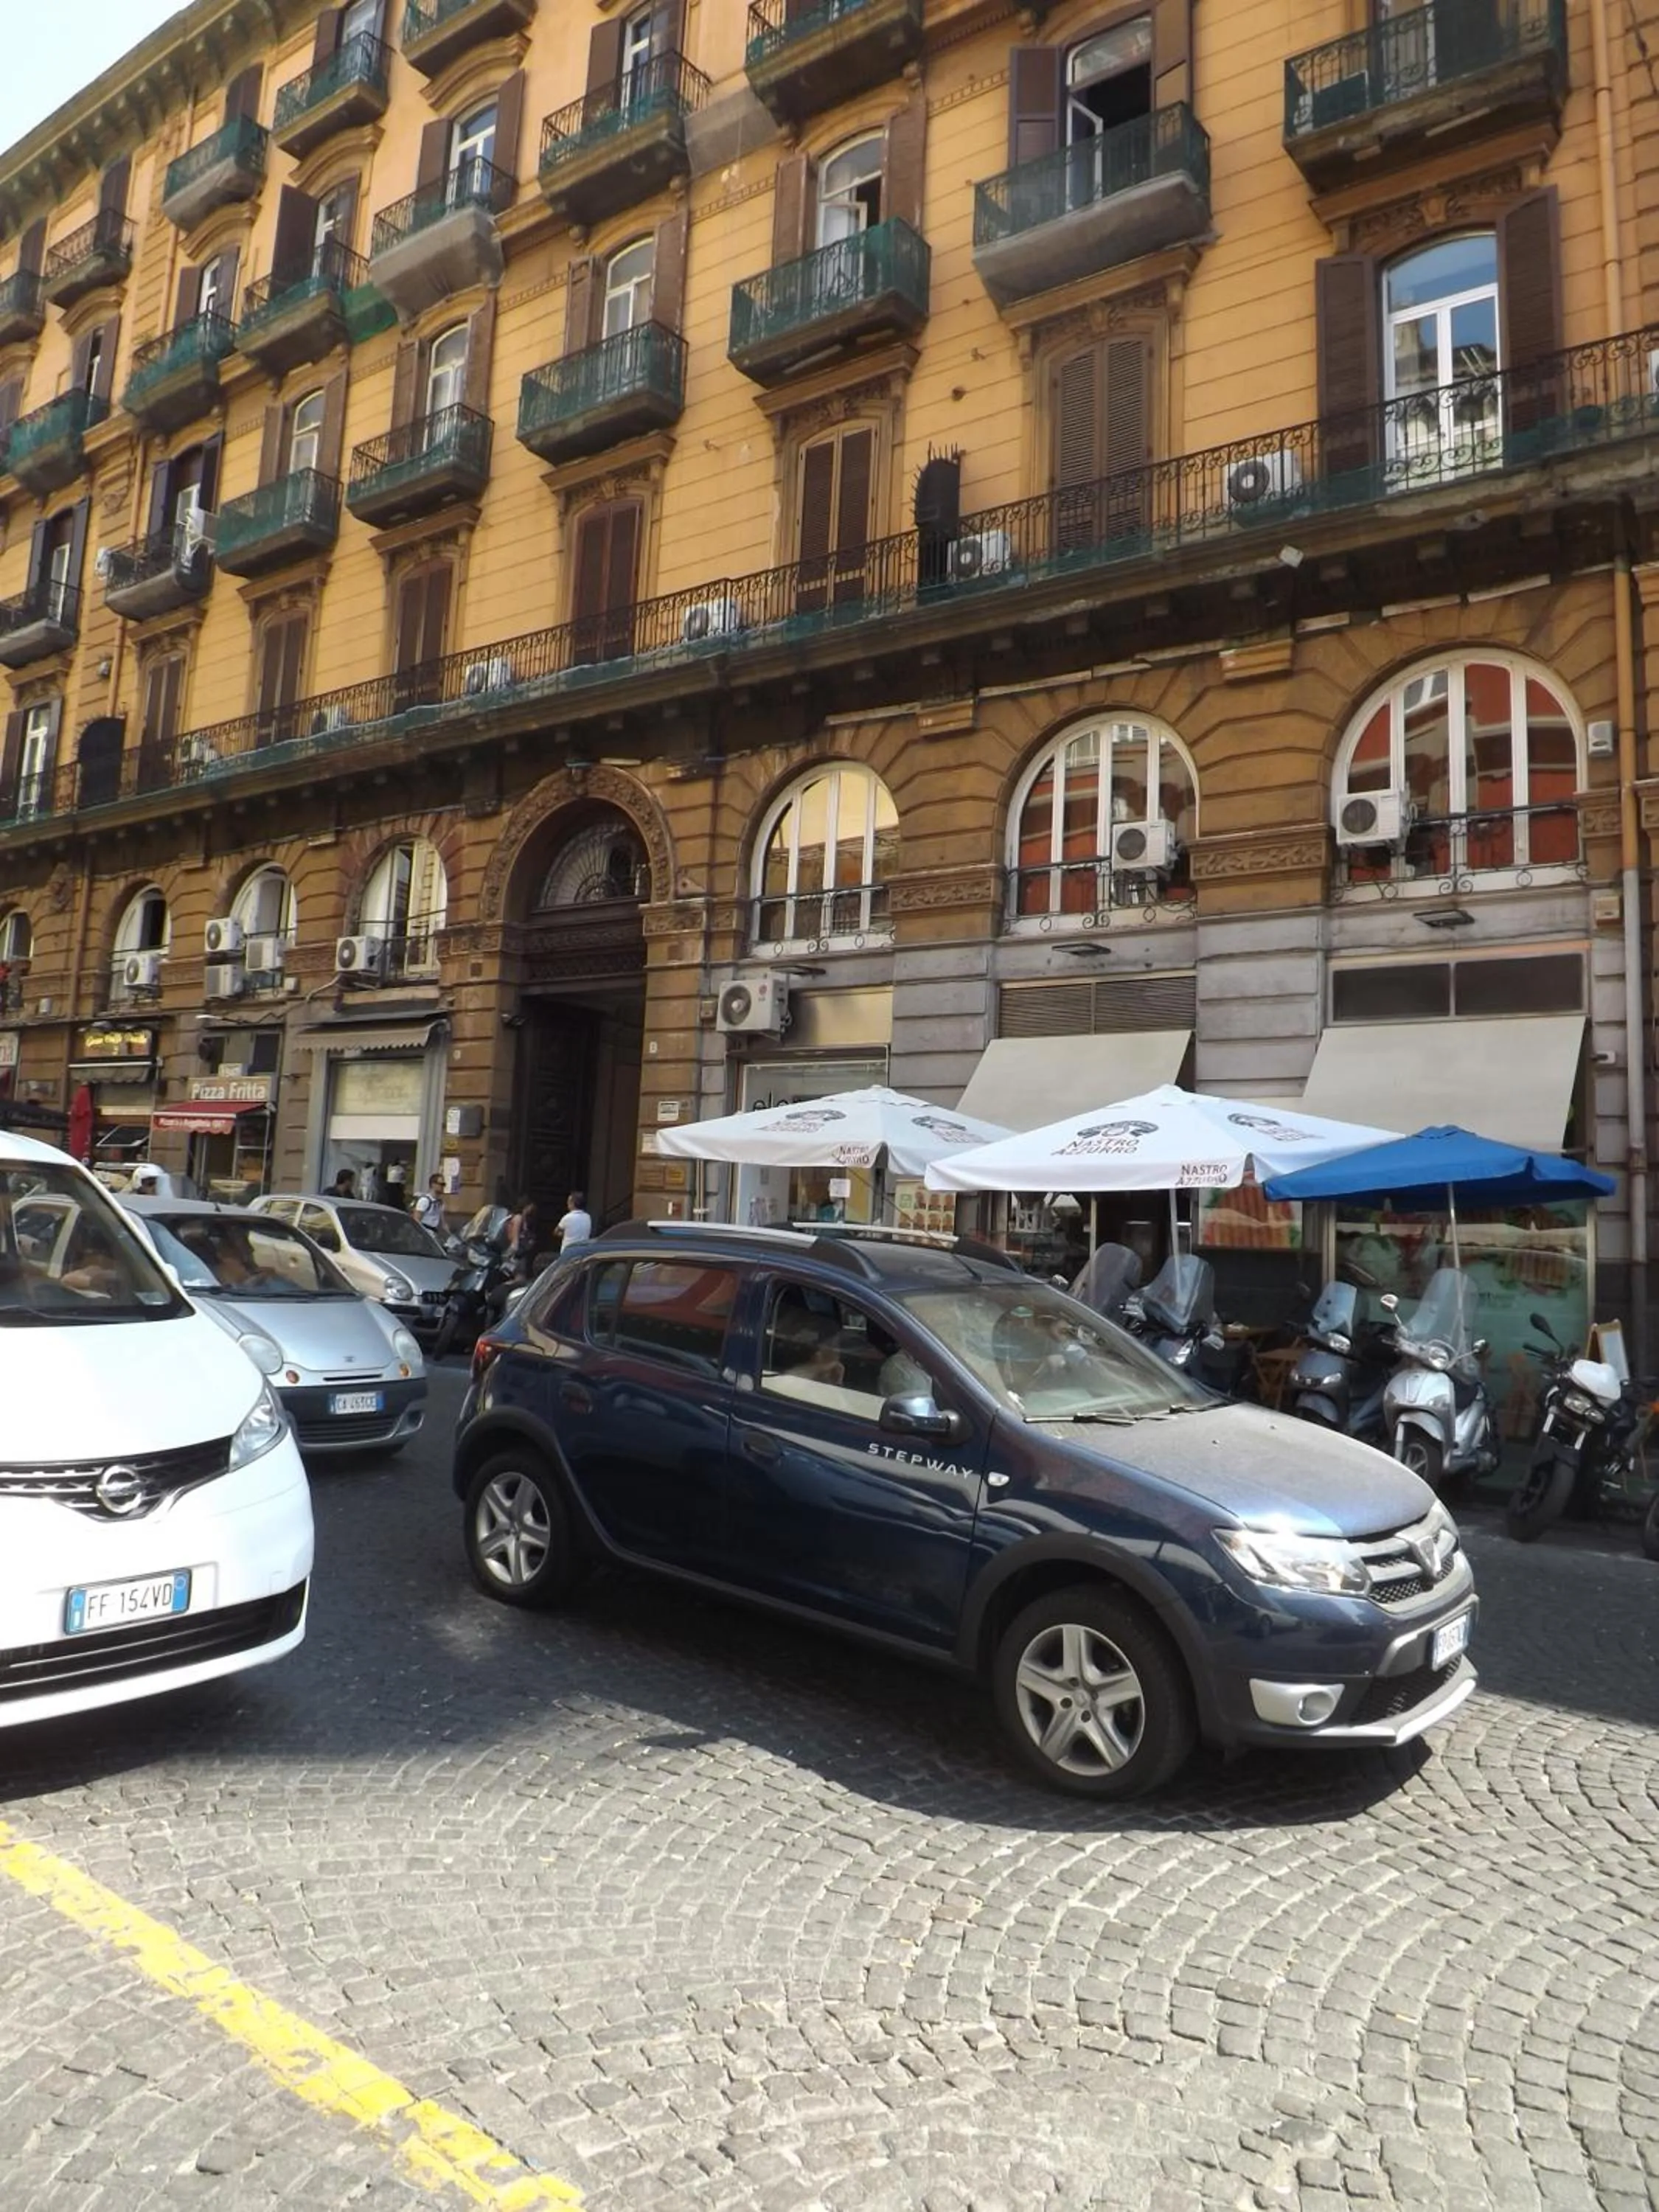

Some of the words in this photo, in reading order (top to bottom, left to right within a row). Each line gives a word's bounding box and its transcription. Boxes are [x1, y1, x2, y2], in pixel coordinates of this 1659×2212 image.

[191, 1082, 224, 1099] Pizza
[229, 1082, 266, 1099] Fritta
[1068, 1138, 1139, 1148] NASTRO
[1181, 1164, 1228, 1176] NASTRO
[867, 1442, 973, 1479] STEPWAY
[87, 1593, 110, 1620] FF
[120, 1583, 173, 1614] 154VD
